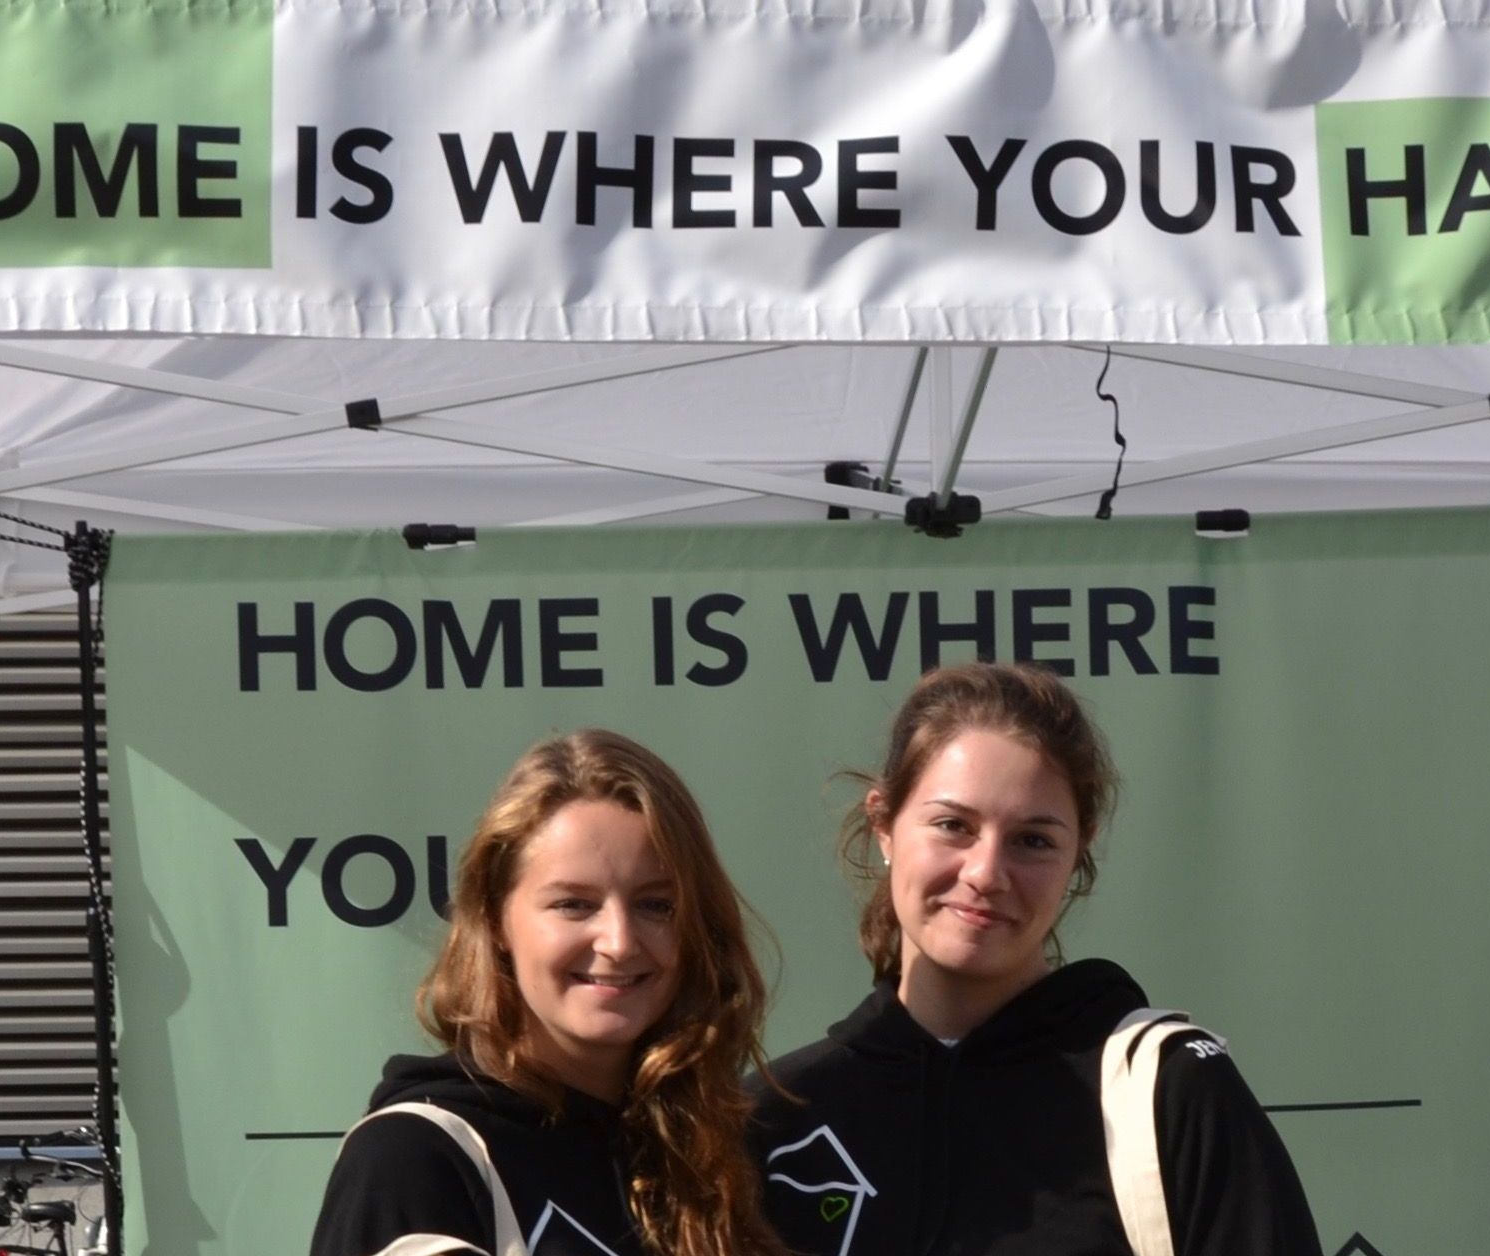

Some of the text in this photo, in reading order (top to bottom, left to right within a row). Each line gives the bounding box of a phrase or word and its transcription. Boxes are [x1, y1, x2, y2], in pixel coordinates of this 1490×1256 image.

[296, 126, 394, 225] IS
[439, 131, 902, 229] WHERE
[946, 135, 1301, 236] YOUR
[237, 585, 1220, 693] HOME IS WHERE
[234, 834, 456, 928] YOU
